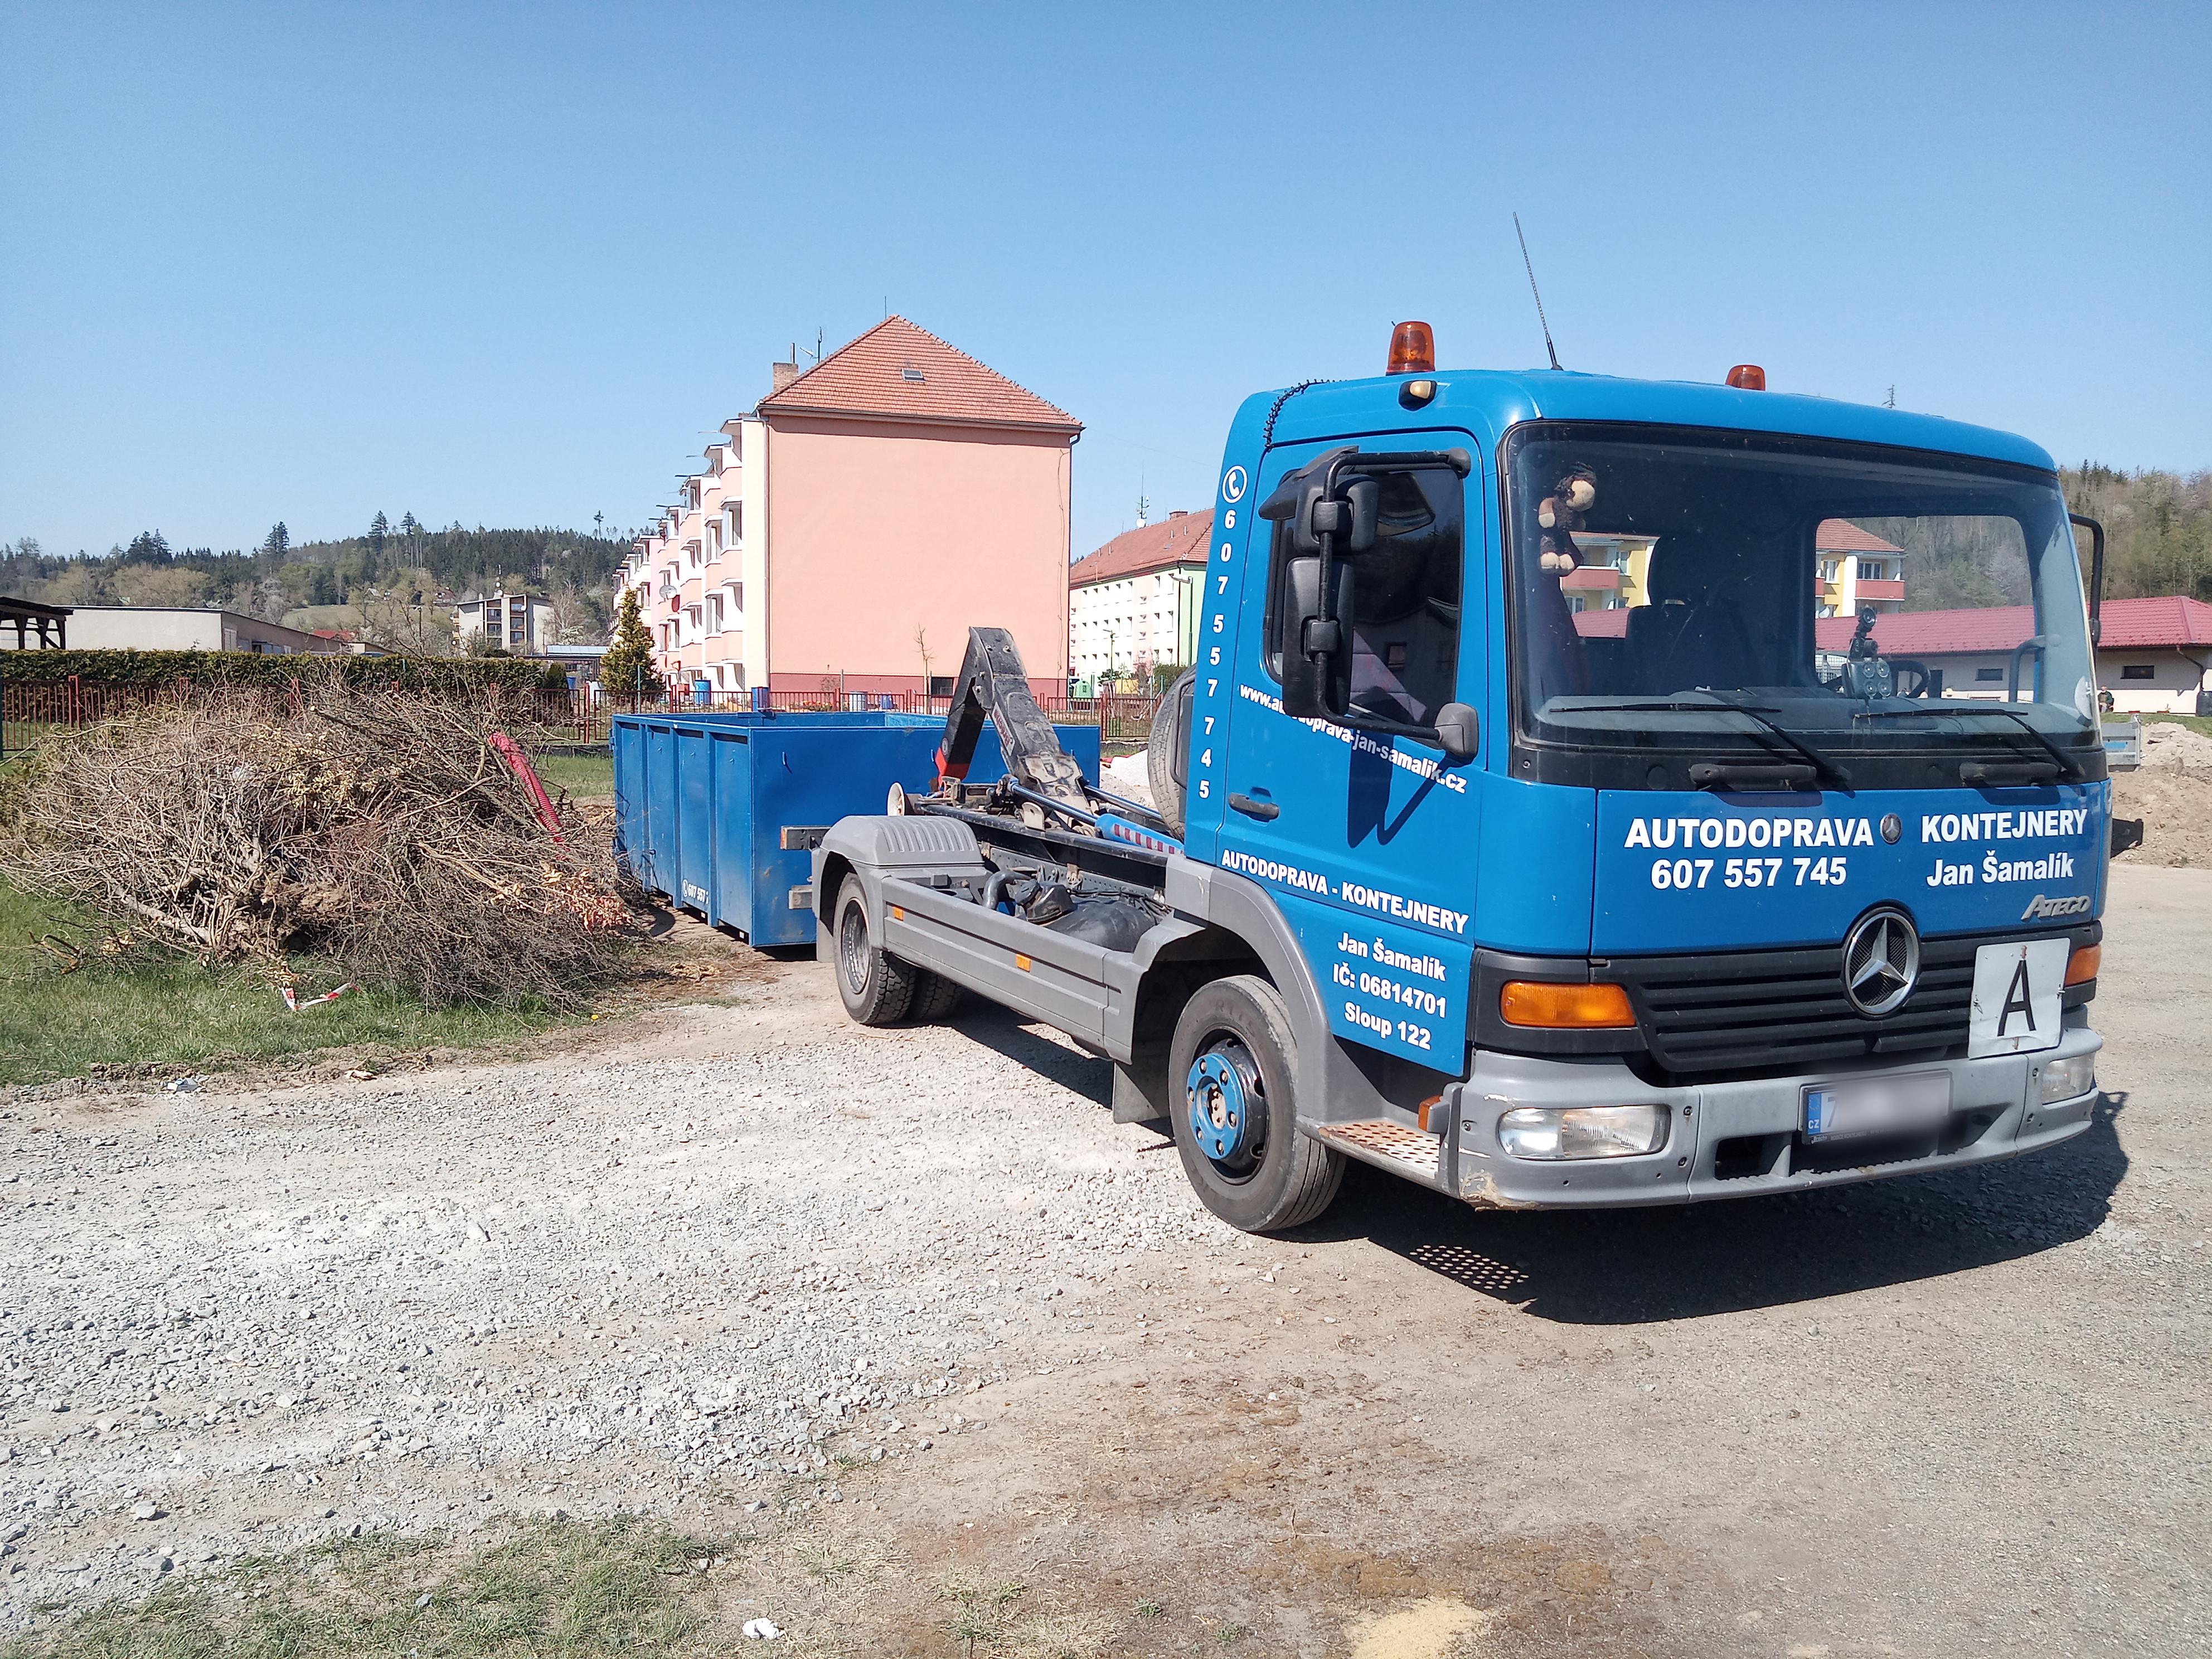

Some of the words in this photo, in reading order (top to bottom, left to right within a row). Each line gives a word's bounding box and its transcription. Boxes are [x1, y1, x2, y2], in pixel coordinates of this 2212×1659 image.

[1624, 818, 1874, 848] AUTODOPRAVA
[1922, 808, 2088, 843] KONTEJNERY
[1651, 859, 1714, 889] 607
[1724, 858, 1783, 888] 557
[1793, 857, 1847, 886] 745
[1927, 859, 1974, 887] Jan
[1981, 850, 2074, 883] Šamalík
[1221, 849, 1328, 895] AUTODOPRAVA
[1342, 881, 1469, 934] KONTEJNERY
[1337, 932, 1368, 958] Jan
[1372, 937, 1446, 982] Šamalík
[1333, 962, 1356, 988] IČ:
[1360, 972, 1446, 1018] 06814701
[1997, 959, 2036, 1037] A
[1344, 1002, 1393, 1039] Sloup
[1397, 1021, 1431, 1050] 122
[1808, 1119, 1820, 1129] CZ
